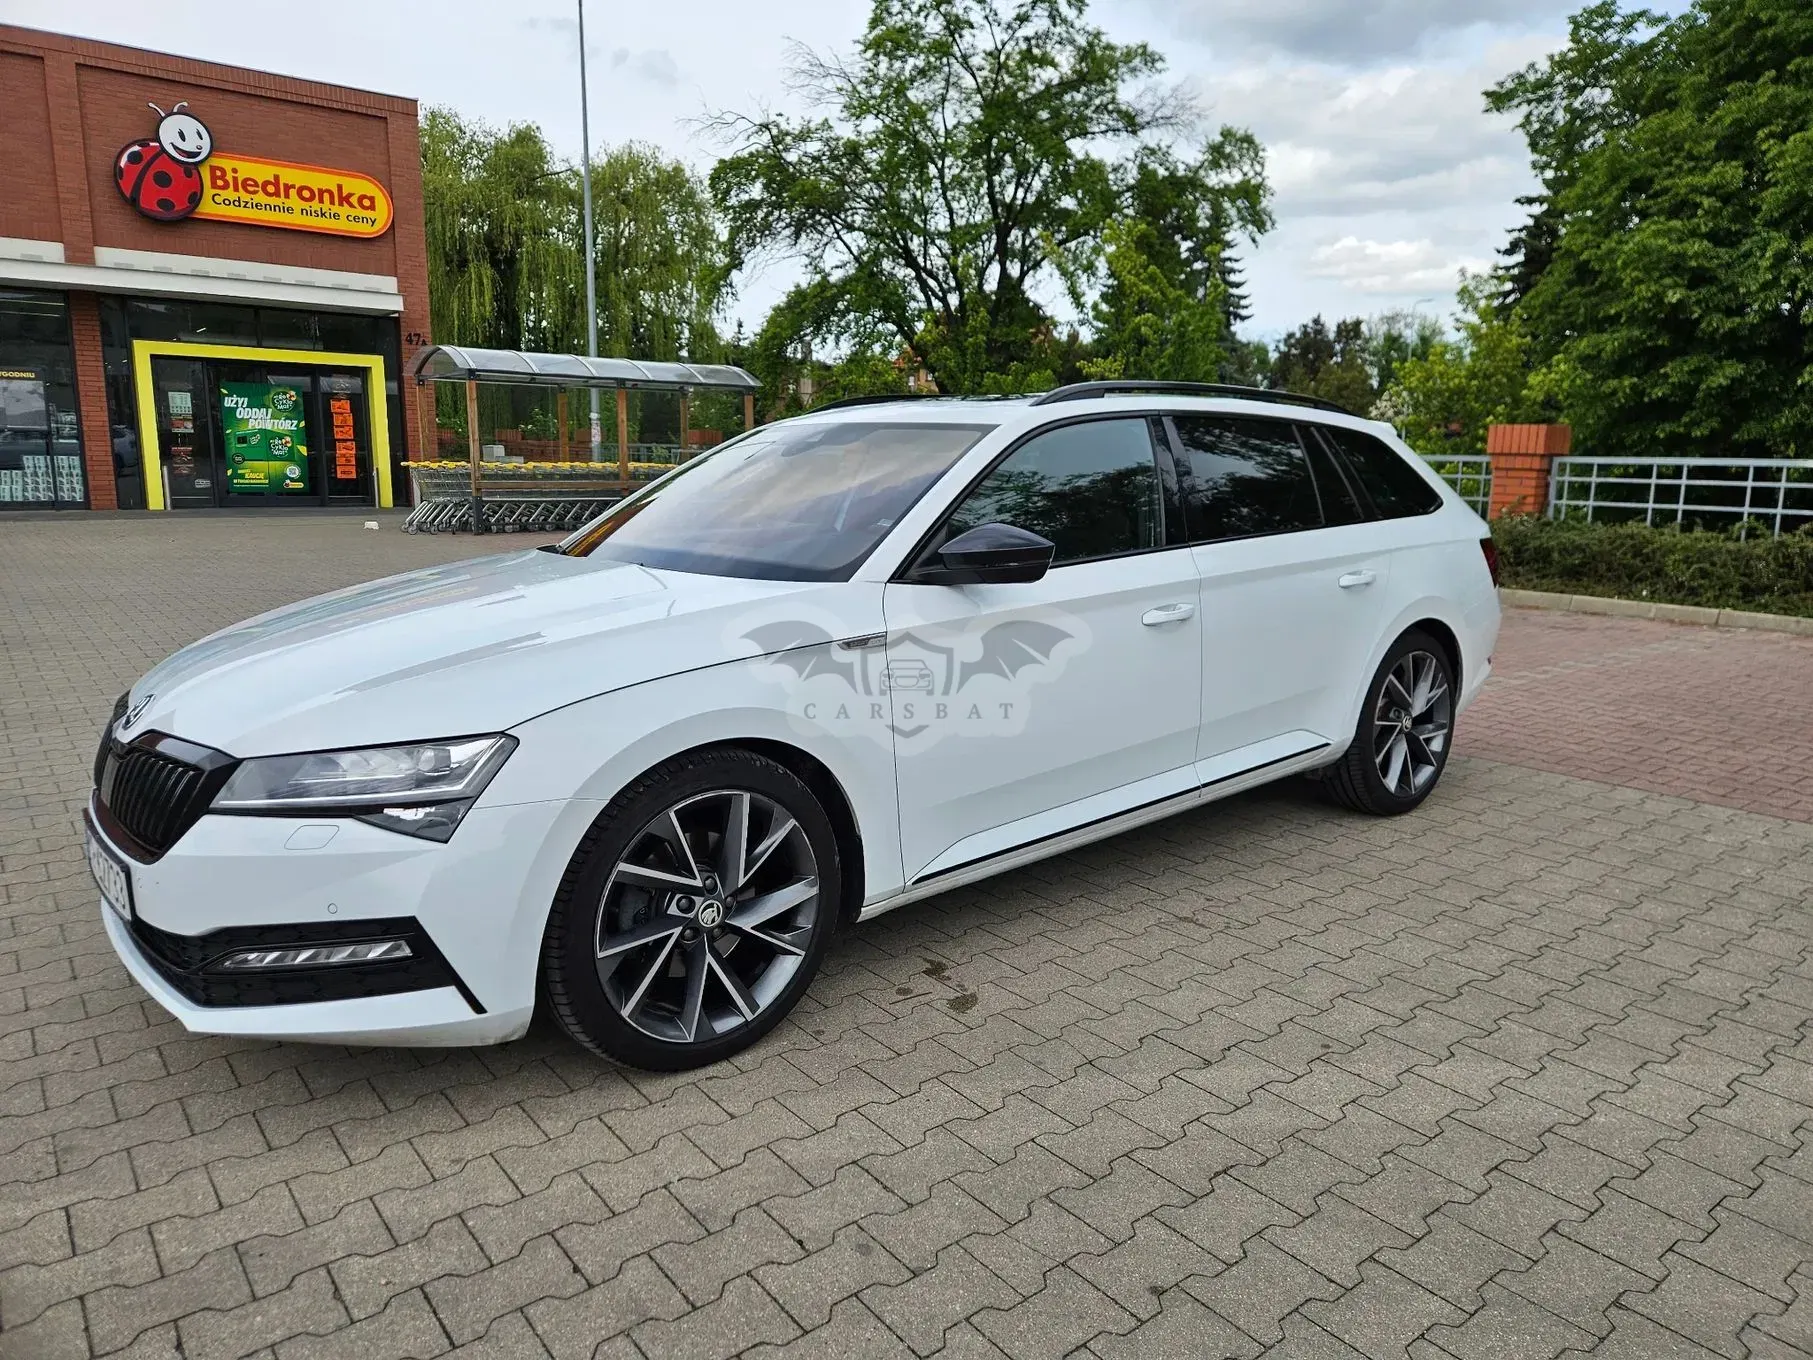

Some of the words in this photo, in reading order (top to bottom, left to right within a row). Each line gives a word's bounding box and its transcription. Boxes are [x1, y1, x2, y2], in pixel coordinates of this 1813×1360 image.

[209, 165, 376, 212] Biedronka
[211, 193, 294, 215] Codziennie
[300, 205, 341, 221] niskie
[346, 213, 377, 227] ceny
[224, 394, 248, 408] UŻYJ
[235, 407, 272, 419] ODDAJ
[248, 417, 298, 430] POWTÓRZ
